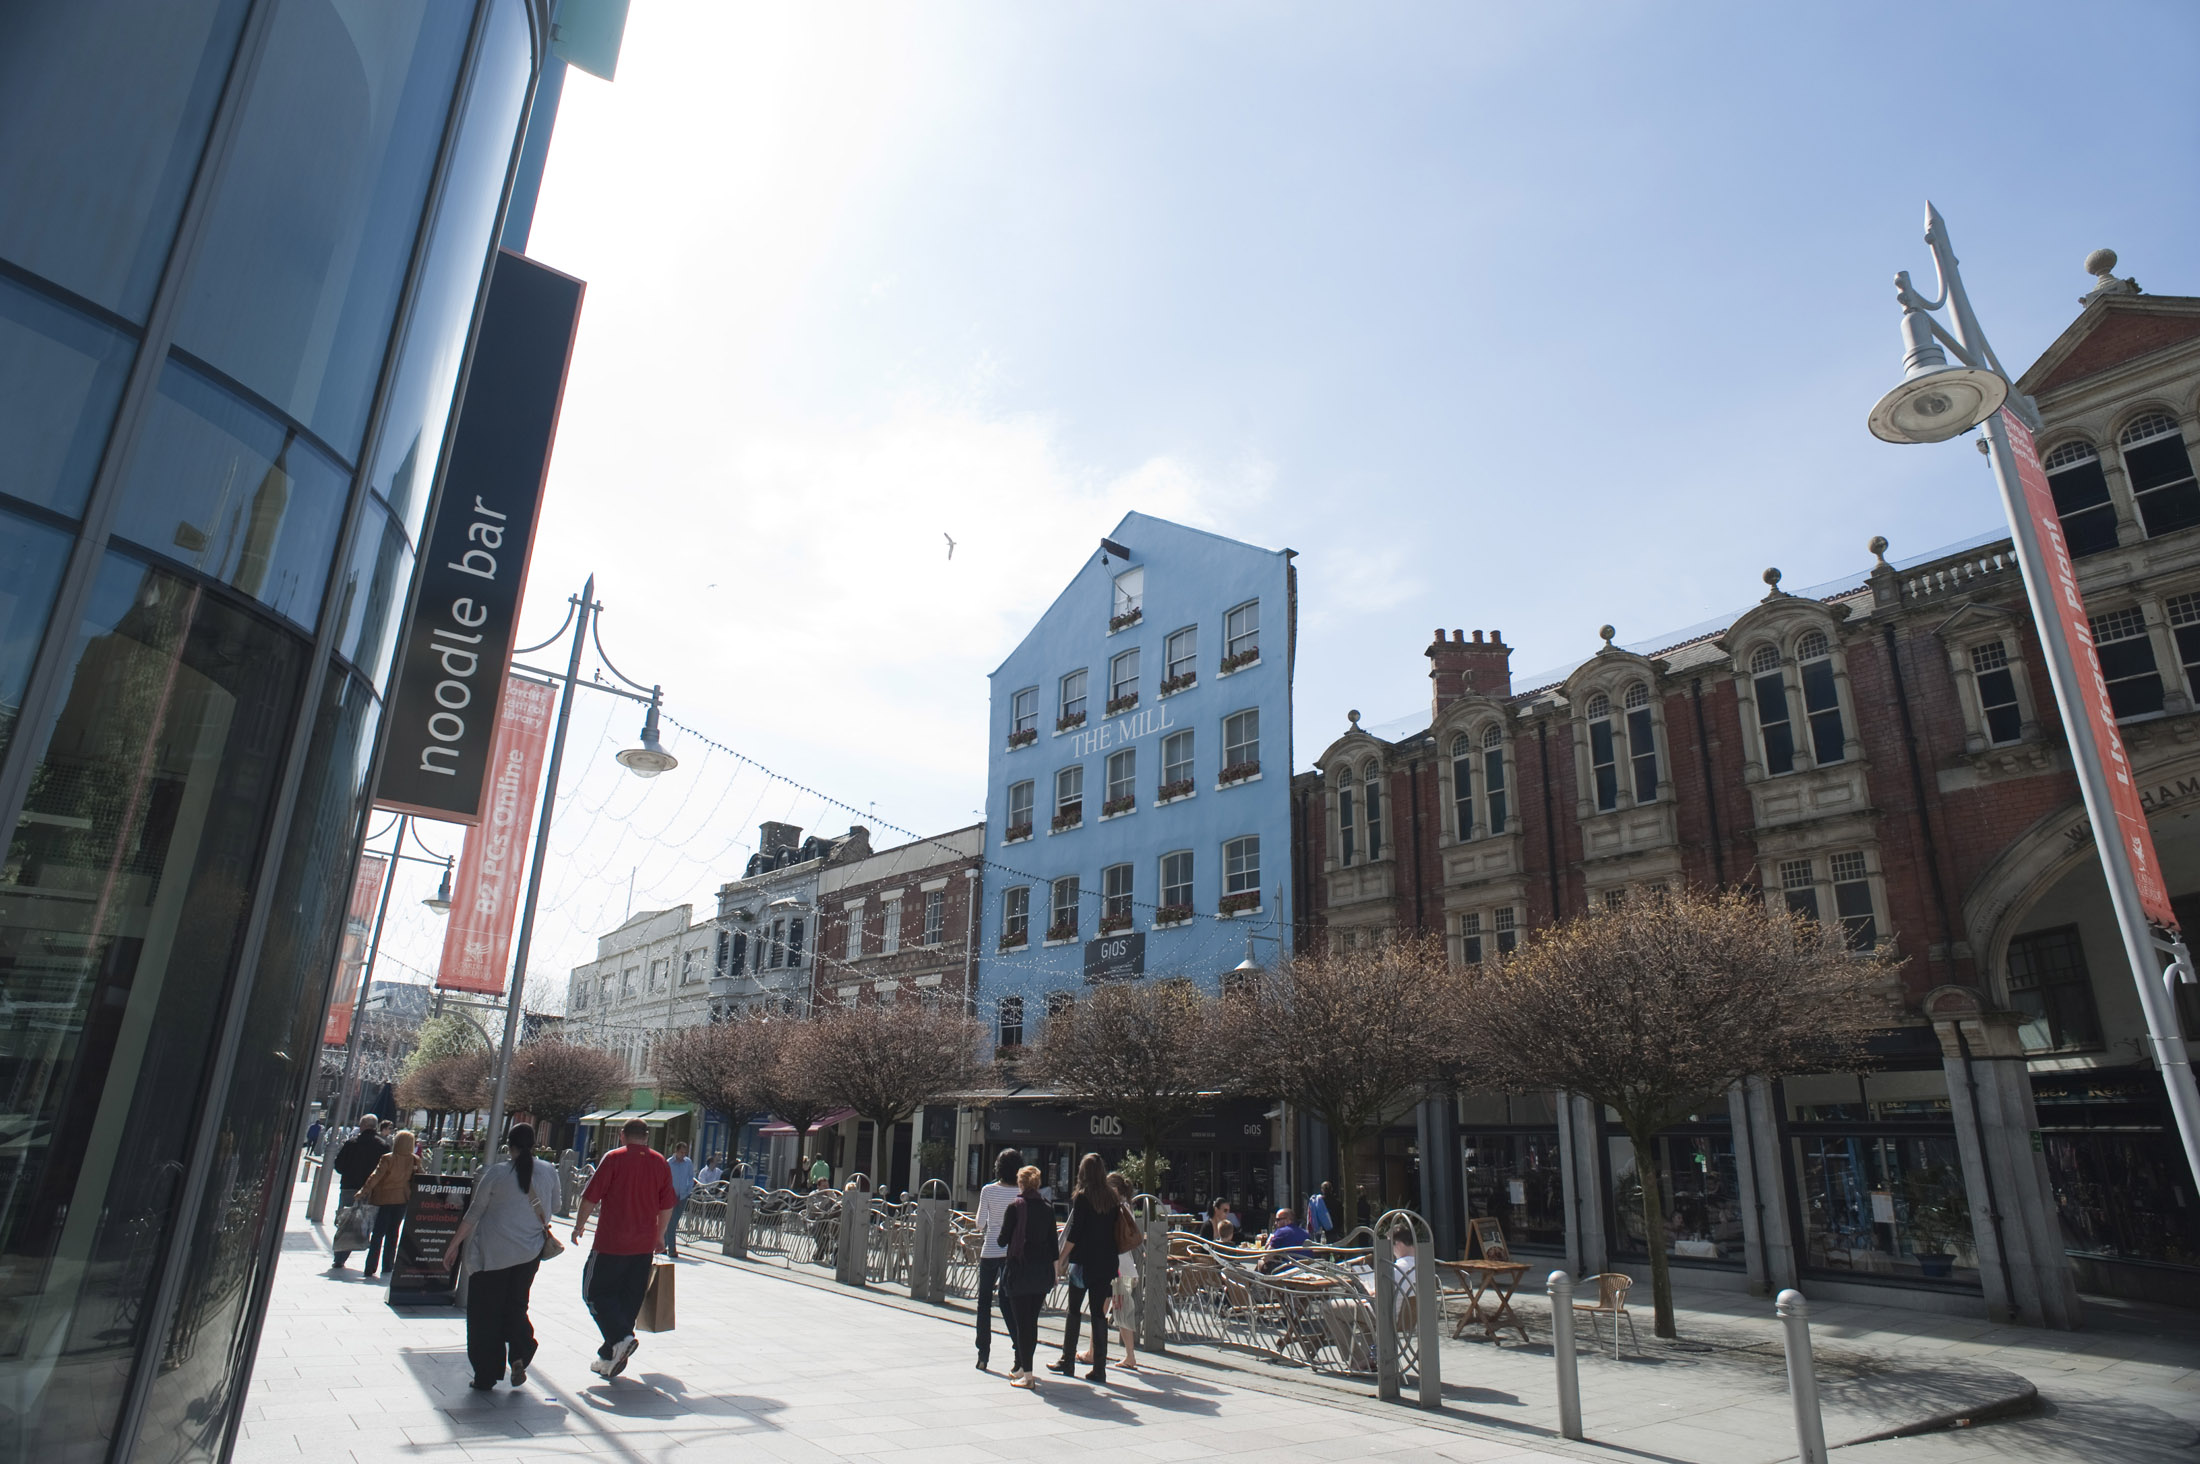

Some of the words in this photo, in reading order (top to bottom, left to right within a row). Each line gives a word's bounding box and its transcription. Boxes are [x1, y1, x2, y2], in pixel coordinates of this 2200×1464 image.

[448, 495, 507, 580] bar
[2042, 517, 2082, 613] Plant
[420, 597, 488, 776] noodle
[503, 708, 543, 729] ibrary
[2073, 621, 2130, 786] Llyfrgell
[1071, 723, 1112, 758] THE
[1118, 704, 1174, 744] MILL
[493, 749, 524, 827] Online
[484, 834, 509, 877] PCs
[417, 1184, 472, 1195] wagamama
